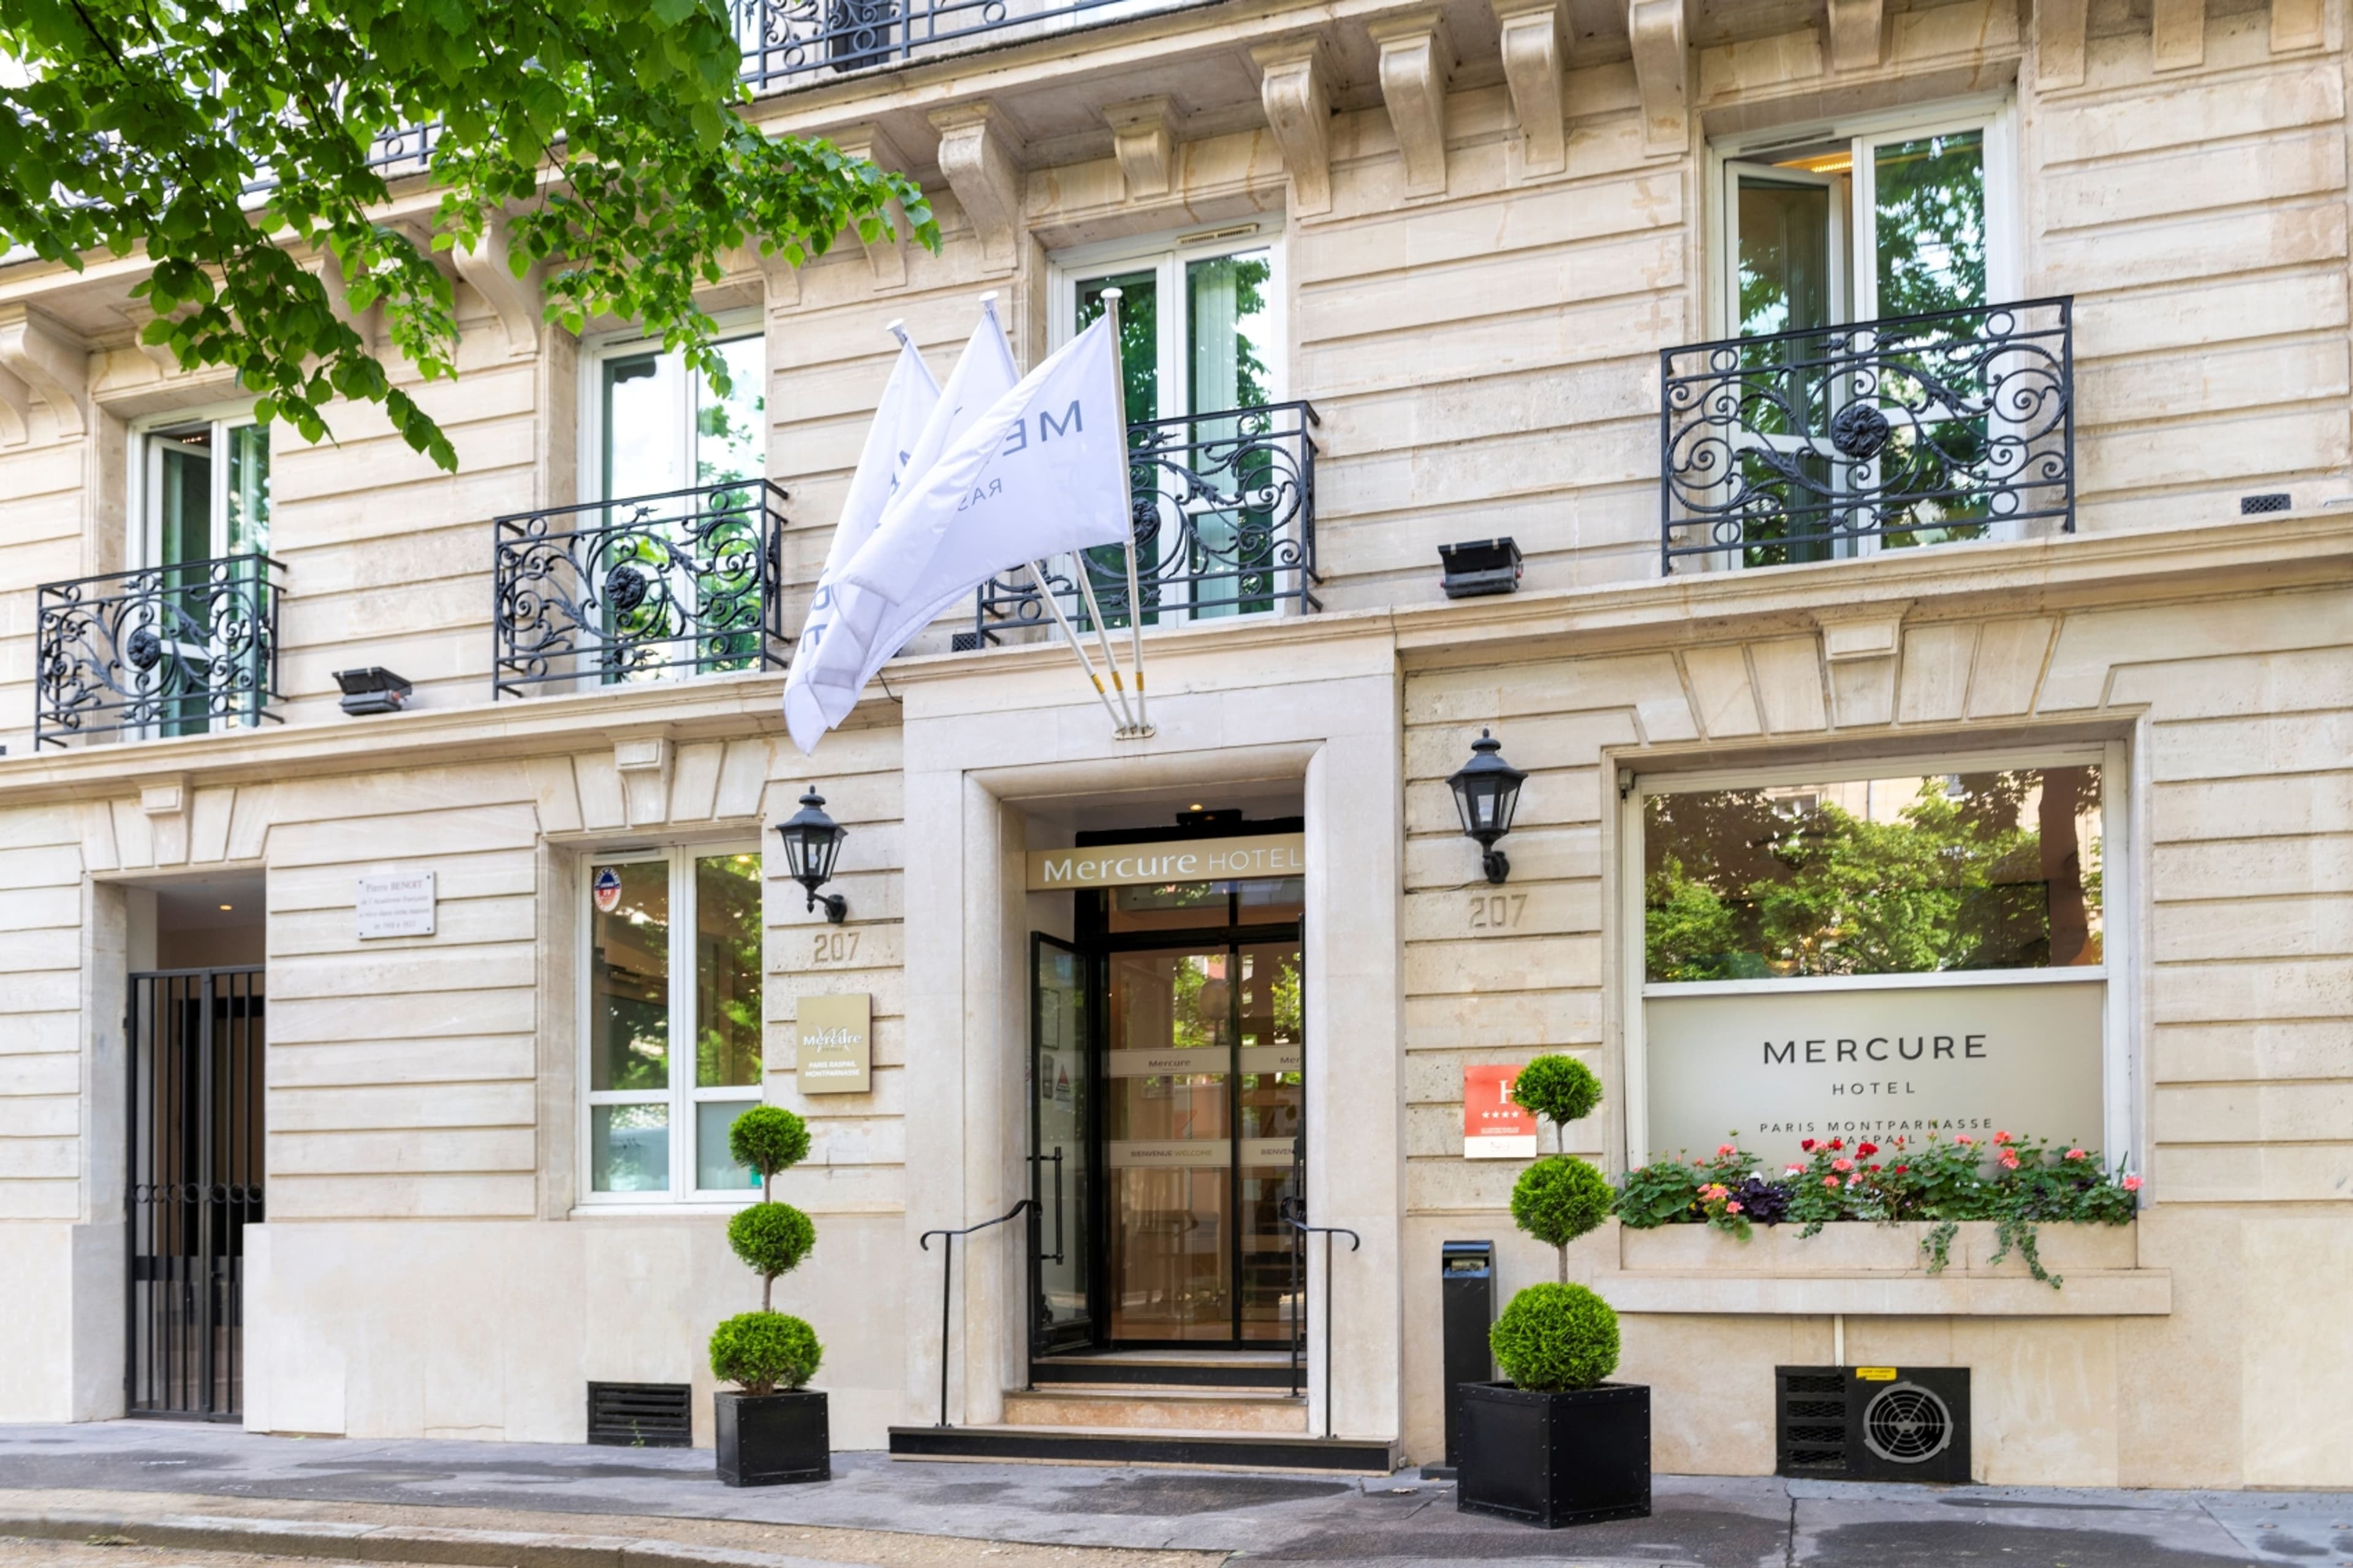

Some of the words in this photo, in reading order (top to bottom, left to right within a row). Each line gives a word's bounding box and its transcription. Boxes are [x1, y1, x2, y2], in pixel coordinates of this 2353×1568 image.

[1044, 853, 1197, 883] Mercure
[1208, 848, 1304, 872] HOTEL
[1470, 893, 1528, 929] 207
[814, 931, 862, 963] 207
[1148, 1059, 1191, 1067] Mercure
[1763, 1034, 1987, 1064] MERCURE
[1832, 1081, 1916, 1096] HOTEL
[1760, 1123, 1814, 1133] PARIS
[1828, 1118, 1992, 1132] MONTPARNASSE
